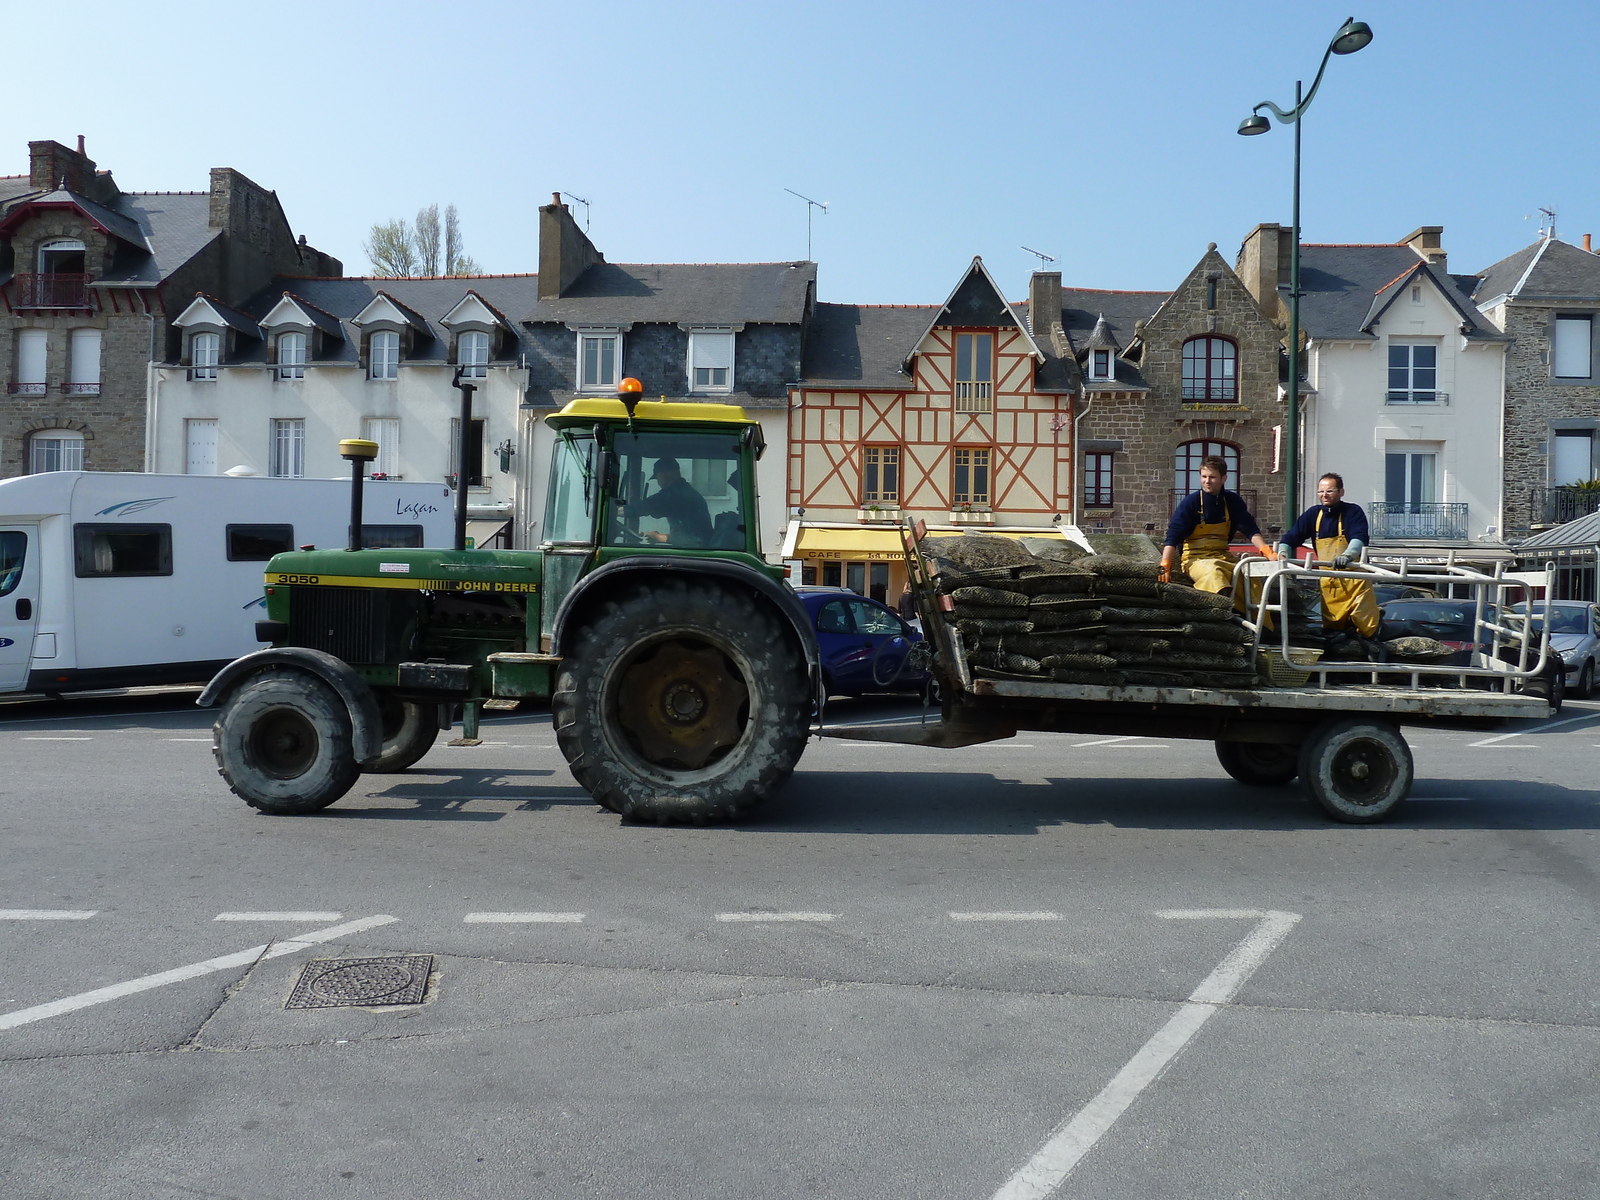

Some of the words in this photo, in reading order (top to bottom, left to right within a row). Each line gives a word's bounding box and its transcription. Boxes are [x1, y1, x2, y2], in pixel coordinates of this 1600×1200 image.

[397, 498, 438, 520] Lagan
[1385, 556, 1410, 564] Ca
[278, 574, 319, 584] 3050
[456, 581, 491, 591] JOHN
[495, 582, 537, 592] DEERE
